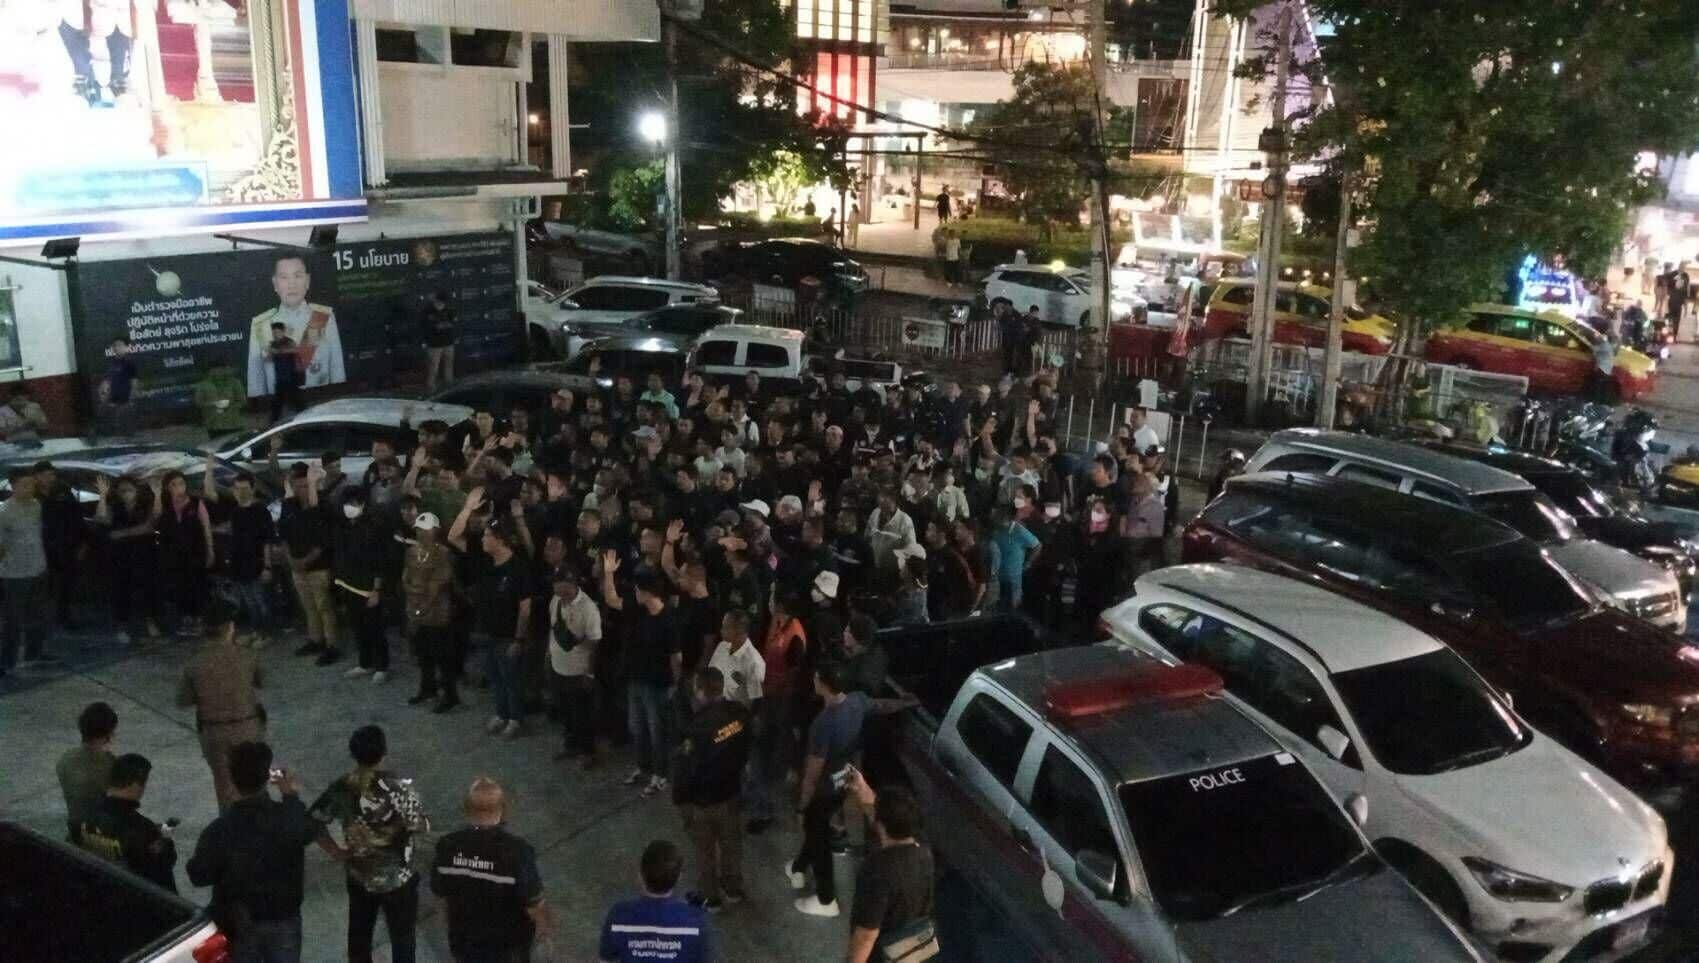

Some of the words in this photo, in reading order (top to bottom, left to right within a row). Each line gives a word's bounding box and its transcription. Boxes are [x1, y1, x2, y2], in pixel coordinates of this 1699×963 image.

[332, 250, 354, 271] 15
[359, 248, 409, 269] นโยบาย
[1189, 767, 1246, 792] POLICE
